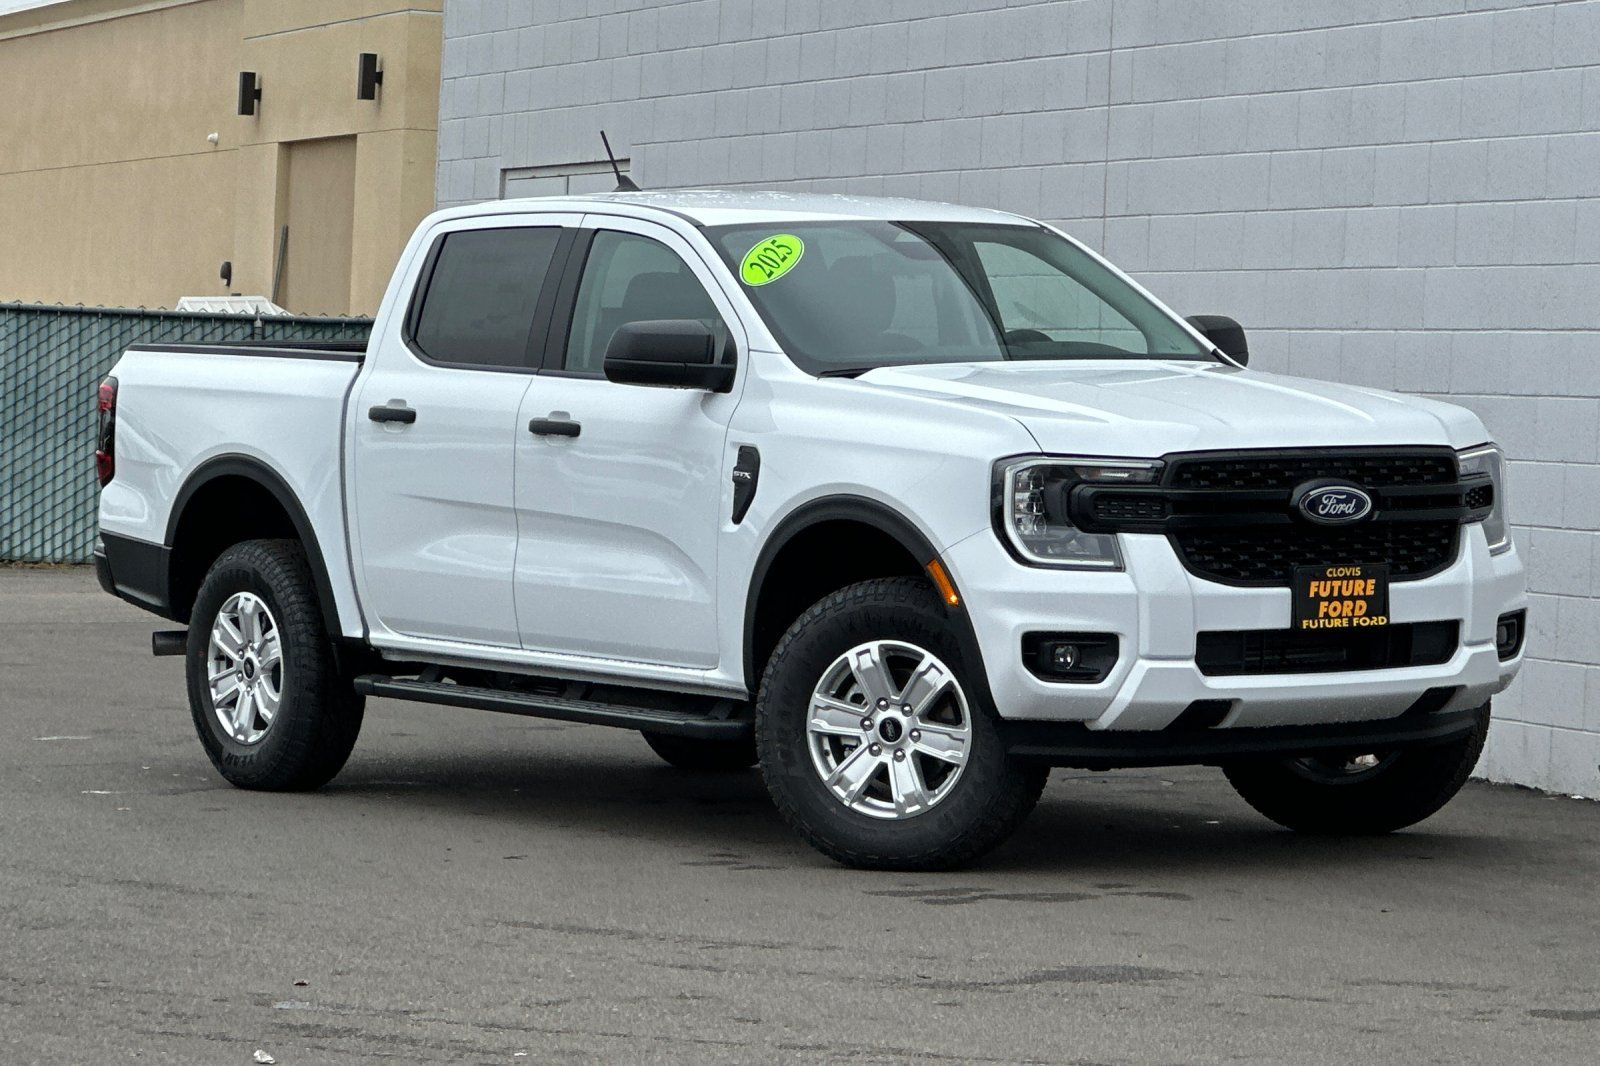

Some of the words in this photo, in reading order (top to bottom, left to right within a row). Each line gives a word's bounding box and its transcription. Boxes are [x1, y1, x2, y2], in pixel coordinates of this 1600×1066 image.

[750, 239, 793, 278] 2025
[1318, 493, 1356, 515] Ford
[1326, 567, 1361, 578] CLOVIS
[1309, 579, 1376, 598] FUTURE
[1318, 600, 1367, 618] FORD
[1302, 617, 1349, 629] FUTURE
[1353, 616, 1388, 627] FORD
